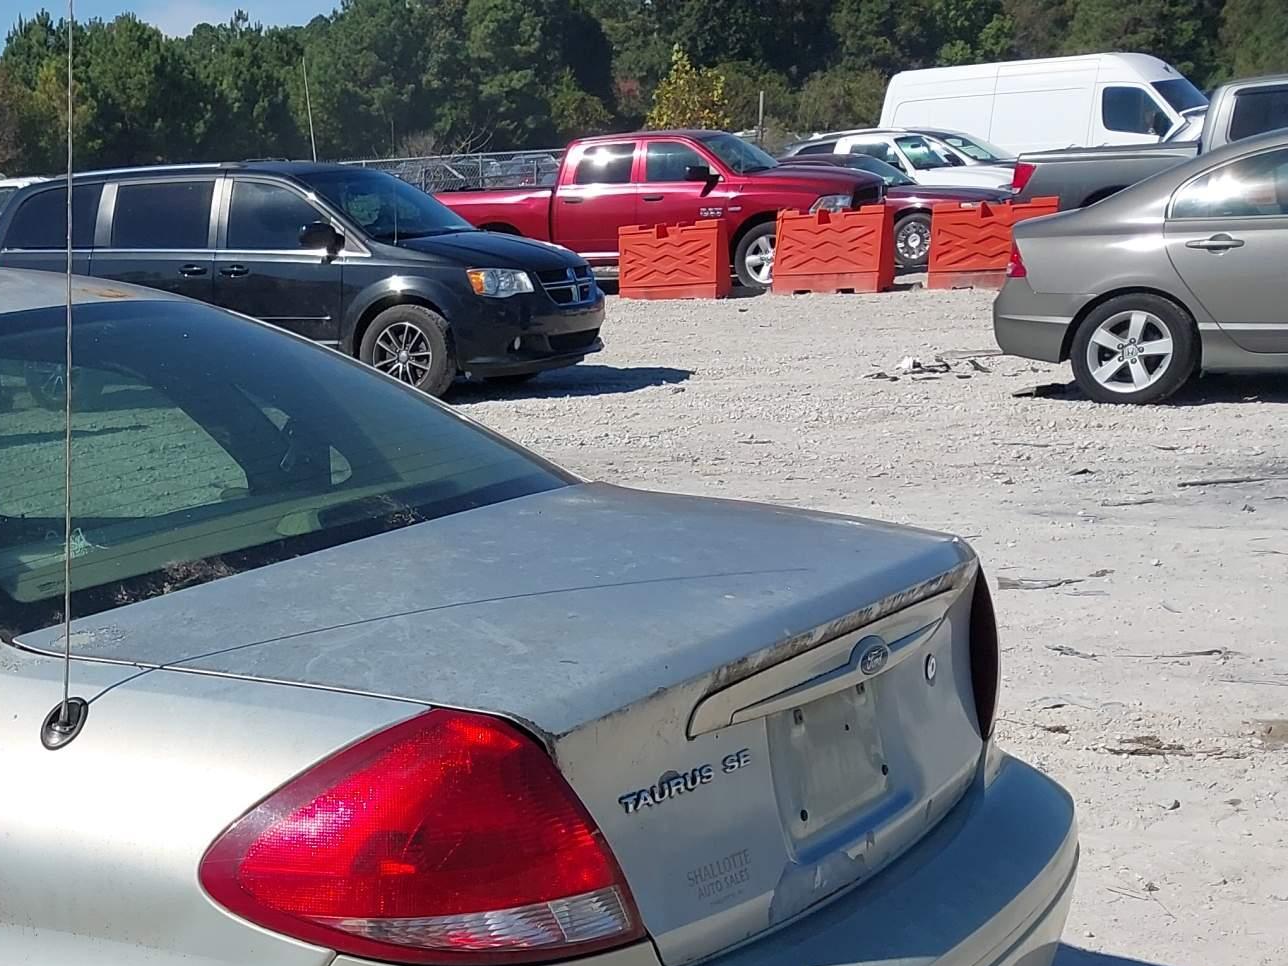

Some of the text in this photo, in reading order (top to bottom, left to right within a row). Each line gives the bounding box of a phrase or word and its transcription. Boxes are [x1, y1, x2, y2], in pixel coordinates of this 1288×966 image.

[618, 748, 752, 814] TAURUS SE
[686, 849, 752, 887] SHALLOTTE
[697, 879, 723, 900] AUTO
[724, 866, 750, 888] SALES
